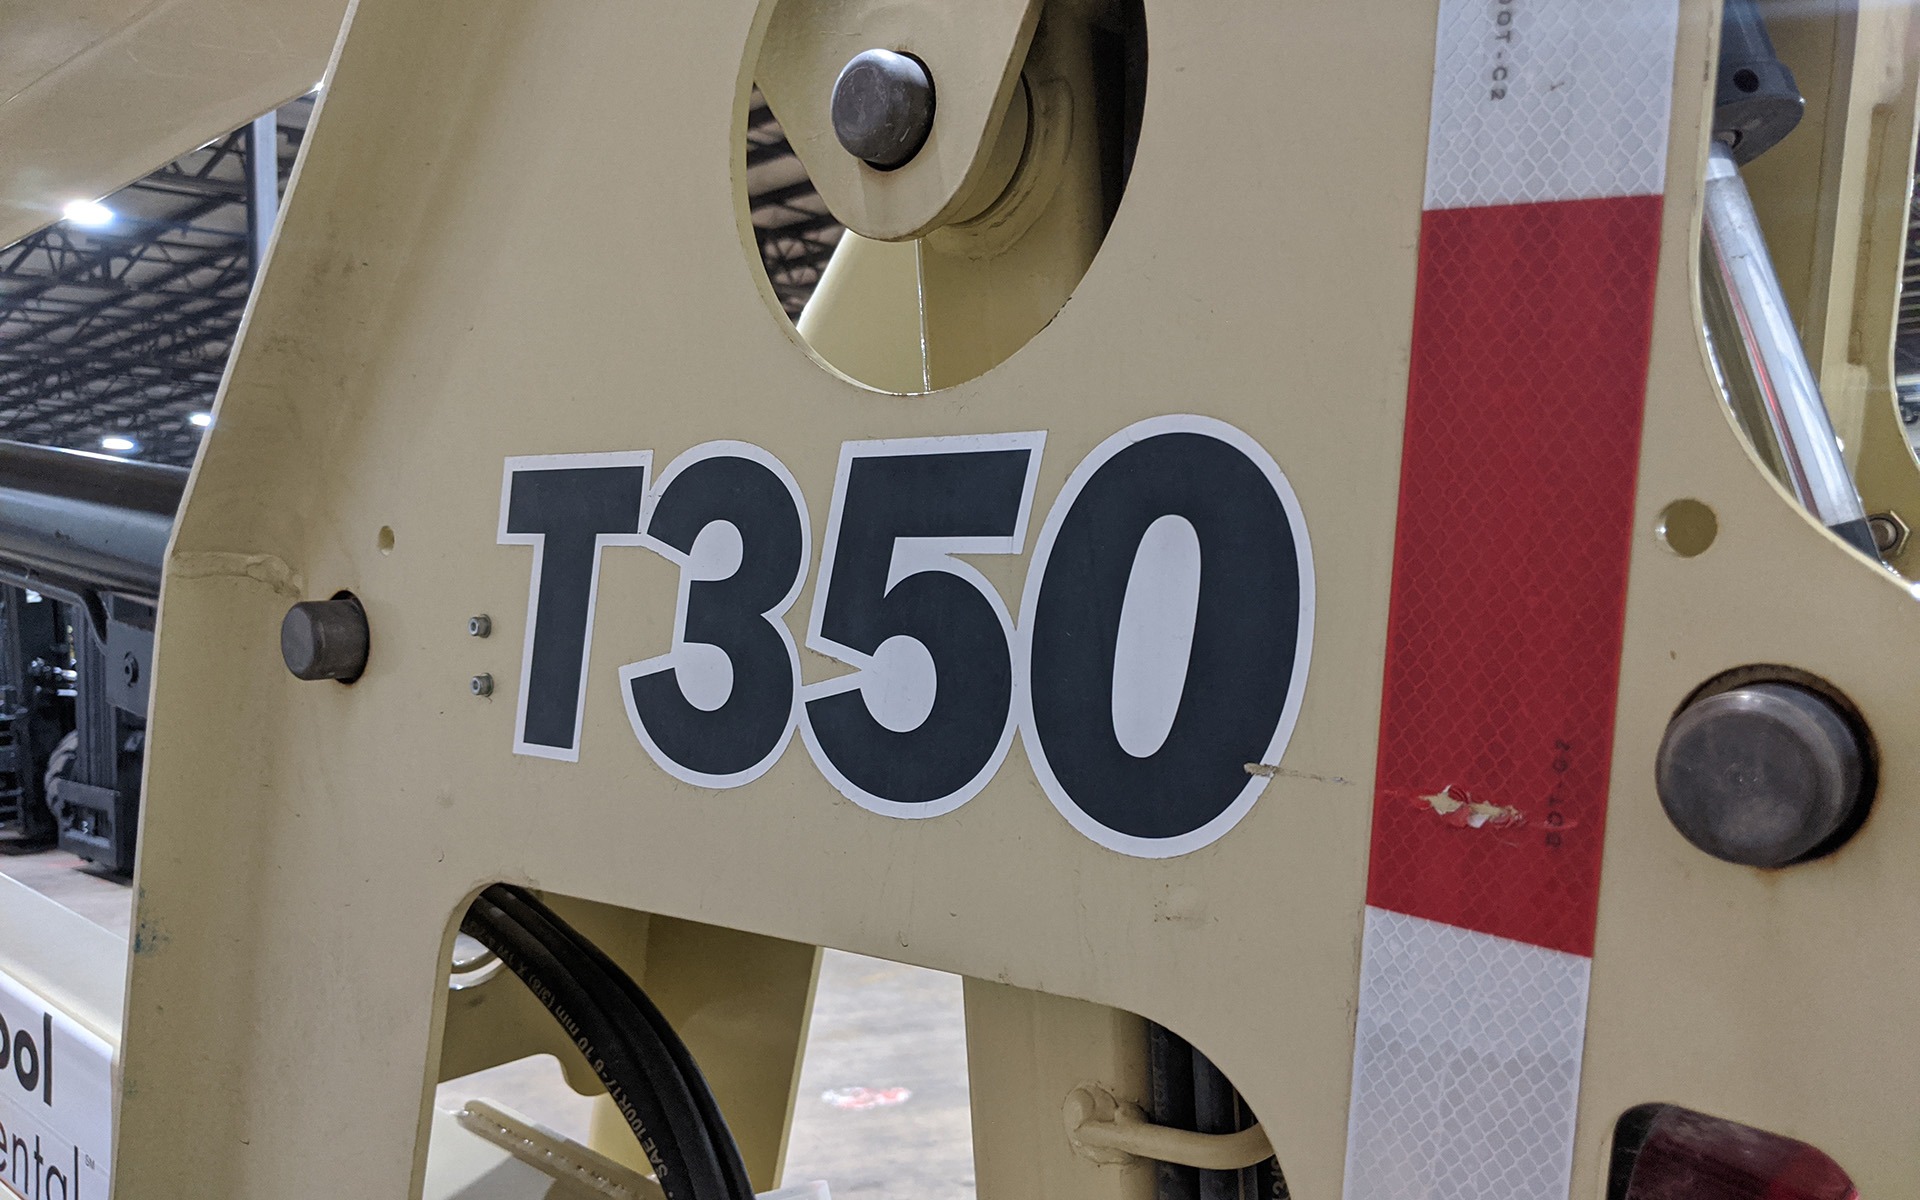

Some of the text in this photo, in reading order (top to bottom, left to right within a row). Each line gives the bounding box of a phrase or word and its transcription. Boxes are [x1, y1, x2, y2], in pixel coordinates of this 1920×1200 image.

[1490, 0, 1512, 101] OT-C2
[503, 427, 1305, 845] T350
[554, 1004, 580, 1037] mm
[578, 1036, 595, 1059] 10
[642, 1136, 669, 1180] SAE
